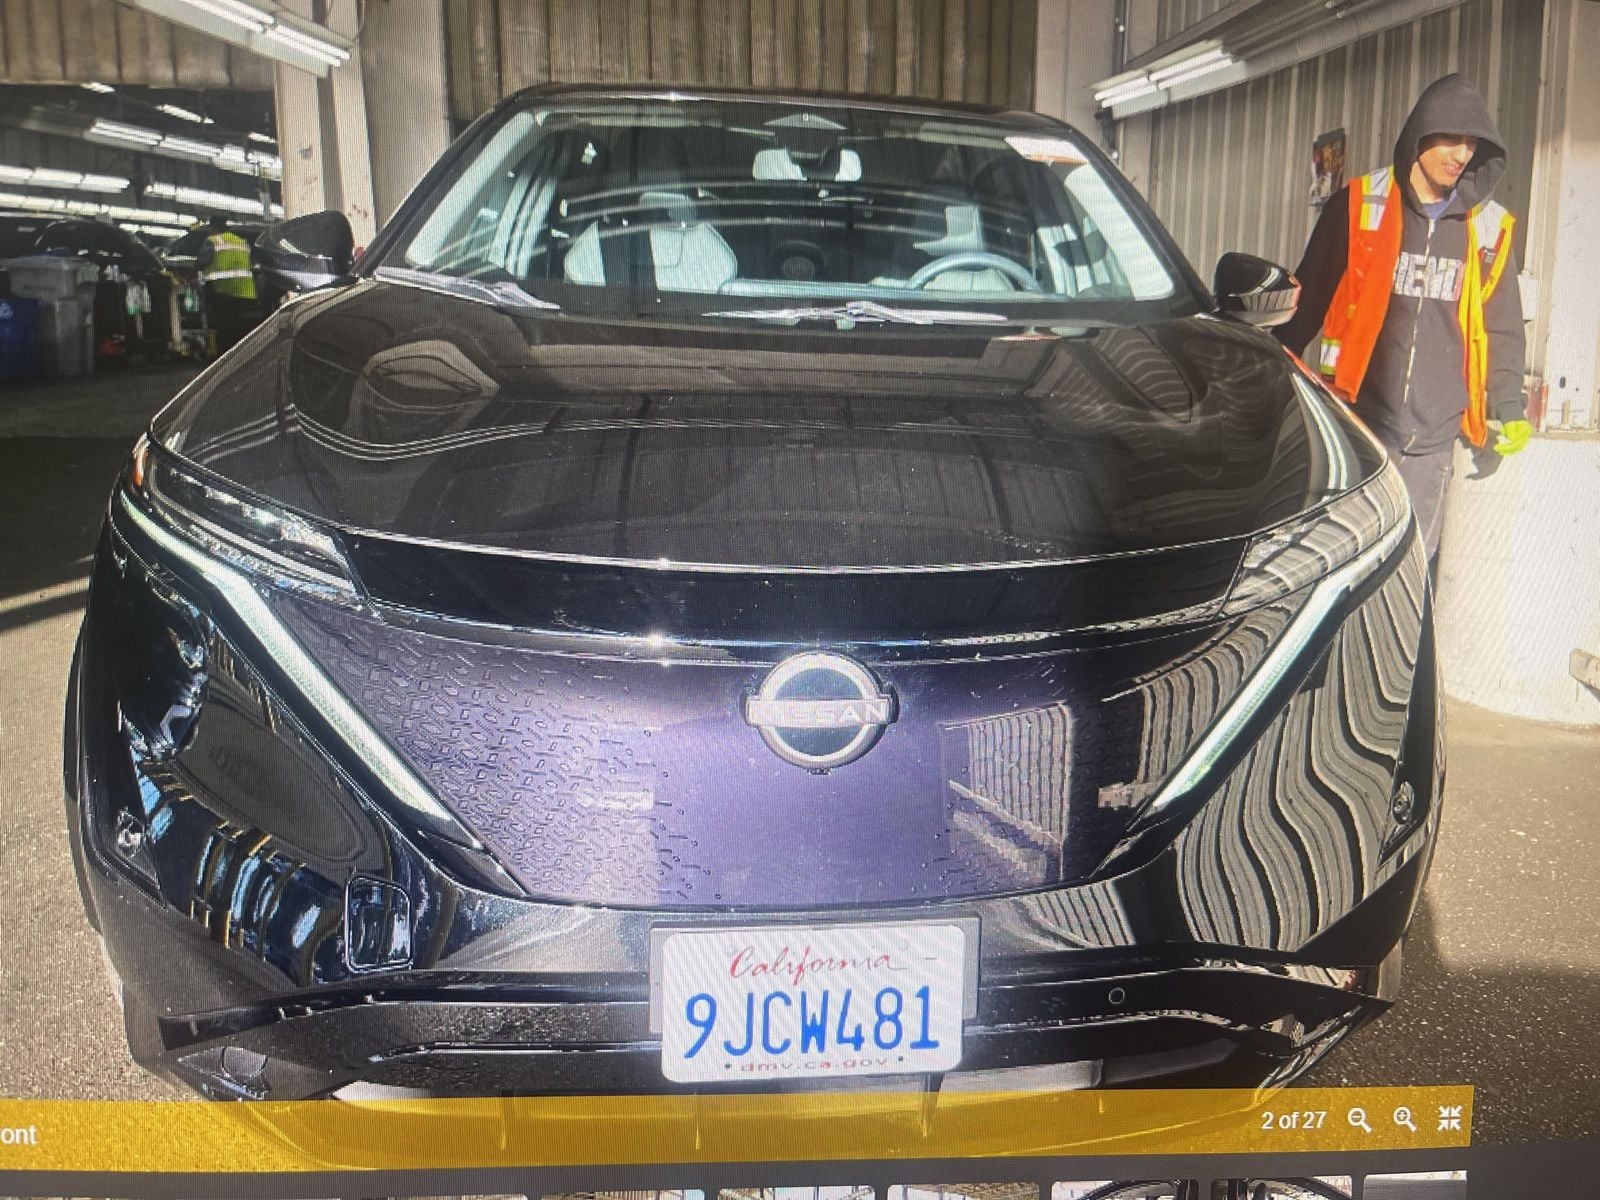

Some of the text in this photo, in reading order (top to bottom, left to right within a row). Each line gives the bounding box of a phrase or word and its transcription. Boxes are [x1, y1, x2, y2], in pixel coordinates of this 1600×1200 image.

[750, 701, 886, 725] NISSAN
[730, 946, 907, 985] California
[684, 986, 940, 1058] 9JCW481
[741, 1058, 888, 1072] dmv.ca.gov
[1261, 1111, 1327, 1129] 2 of 27
